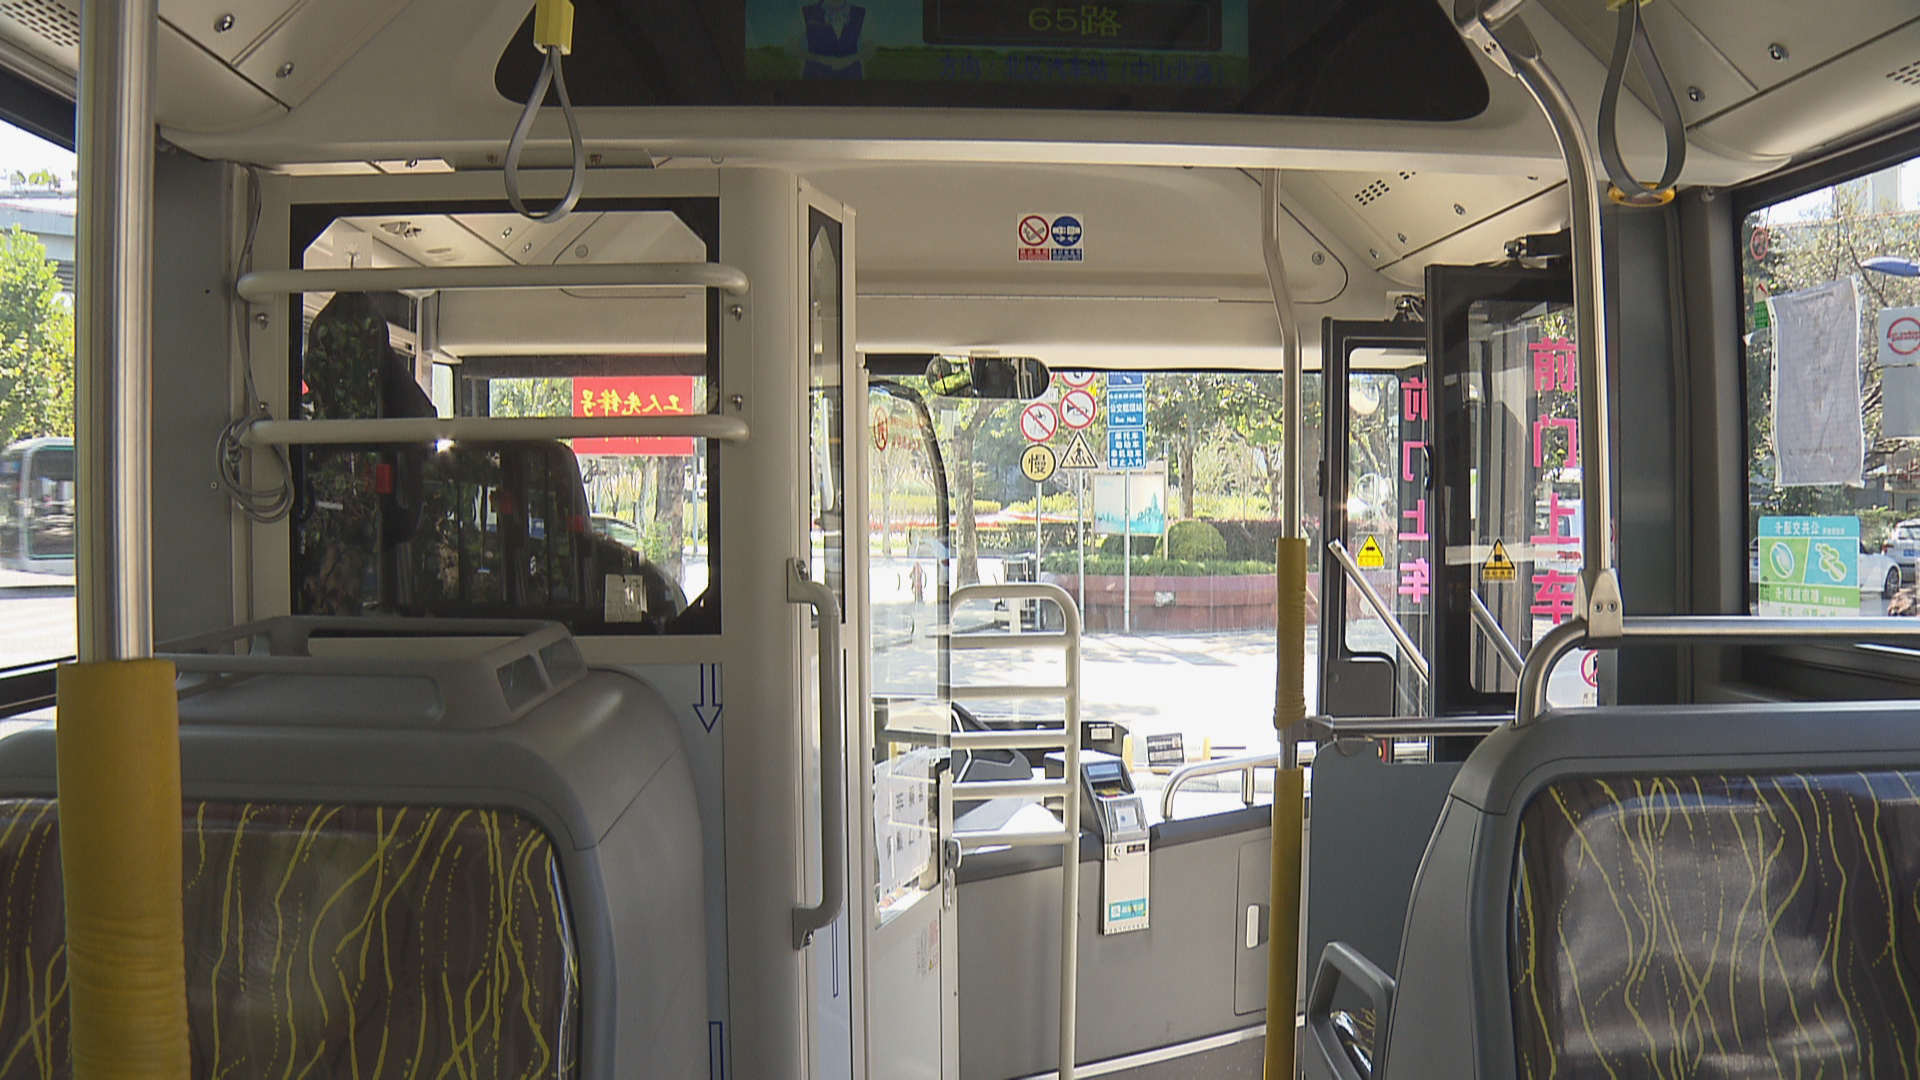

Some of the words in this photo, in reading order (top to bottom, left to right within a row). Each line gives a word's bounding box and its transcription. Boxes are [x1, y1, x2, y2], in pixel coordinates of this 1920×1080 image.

[1027, 4, 1123, 38] 65路
[1528, 336, 1581, 626] 前门上车
